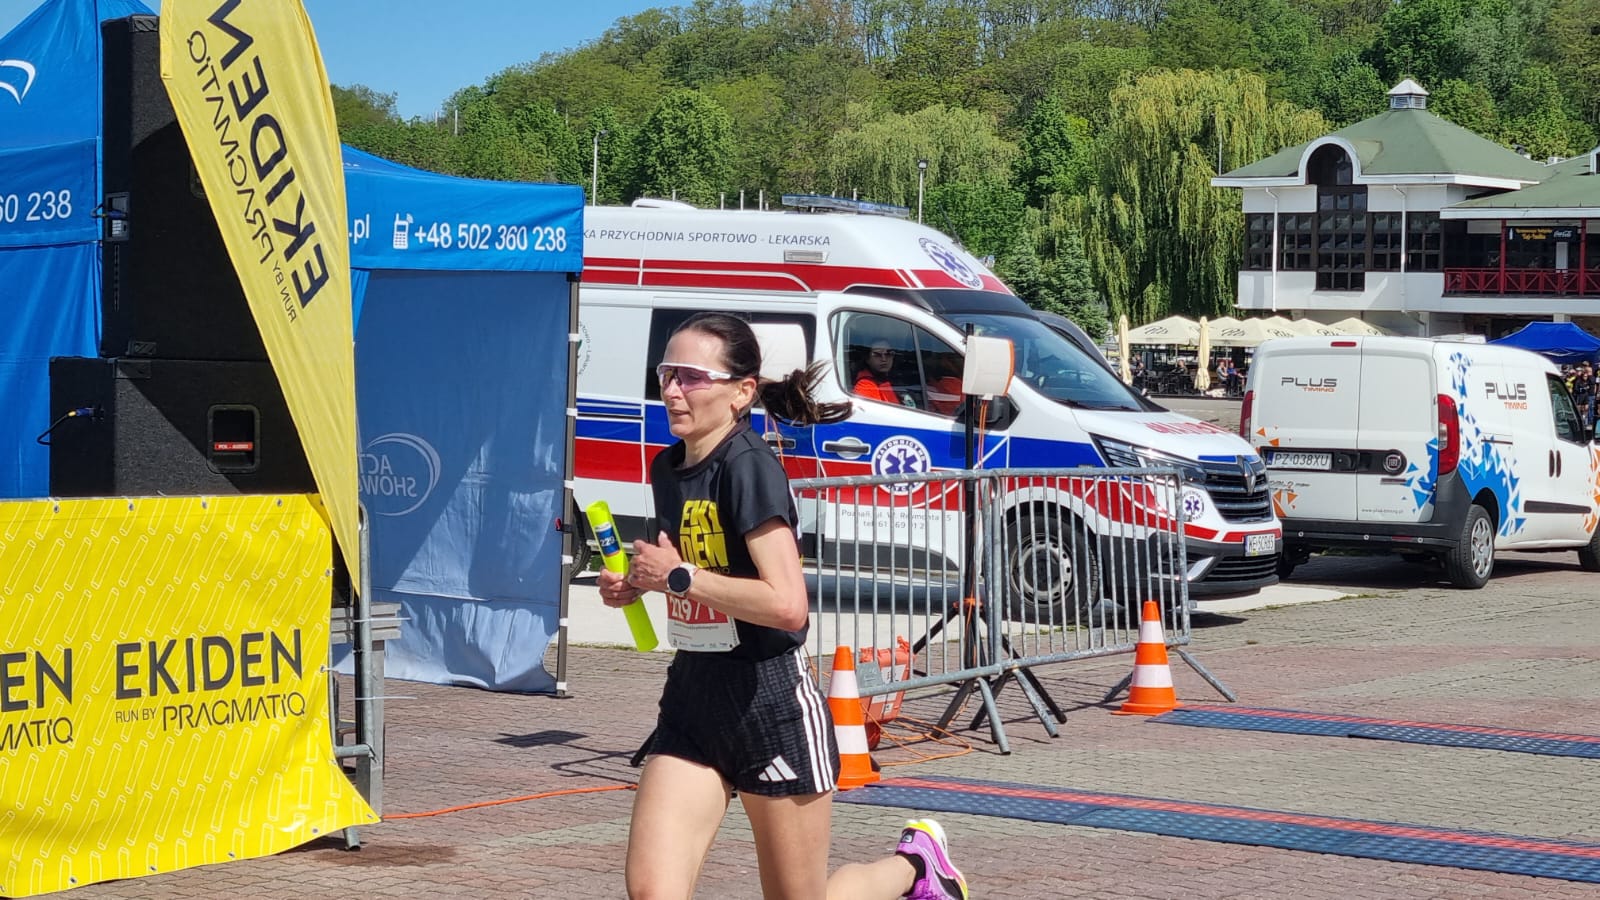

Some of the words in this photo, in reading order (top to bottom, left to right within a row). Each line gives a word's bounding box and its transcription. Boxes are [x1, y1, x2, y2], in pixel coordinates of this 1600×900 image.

[26, 189, 72, 221] 238
[414, 222, 452, 248] +48
[458, 223, 493, 250] 502
[494, 224, 528, 251] 360
[533, 226, 566, 252] 238
[600, 229, 684, 241] PRZYCHODNIA
[688, 232, 757, 244] SPORTOWO
[768, 234, 831, 246] LEKARSKA
[1281, 377, 1337, 387] PLUS
[1485, 382, 1527, 400] PLUS
[1504, 401, 1528, 410] TIMING
[115, 628, 303, 700] EKIDEN
[115, 709, 139, 724] RUN
[142, 707, 157, 721] BY
